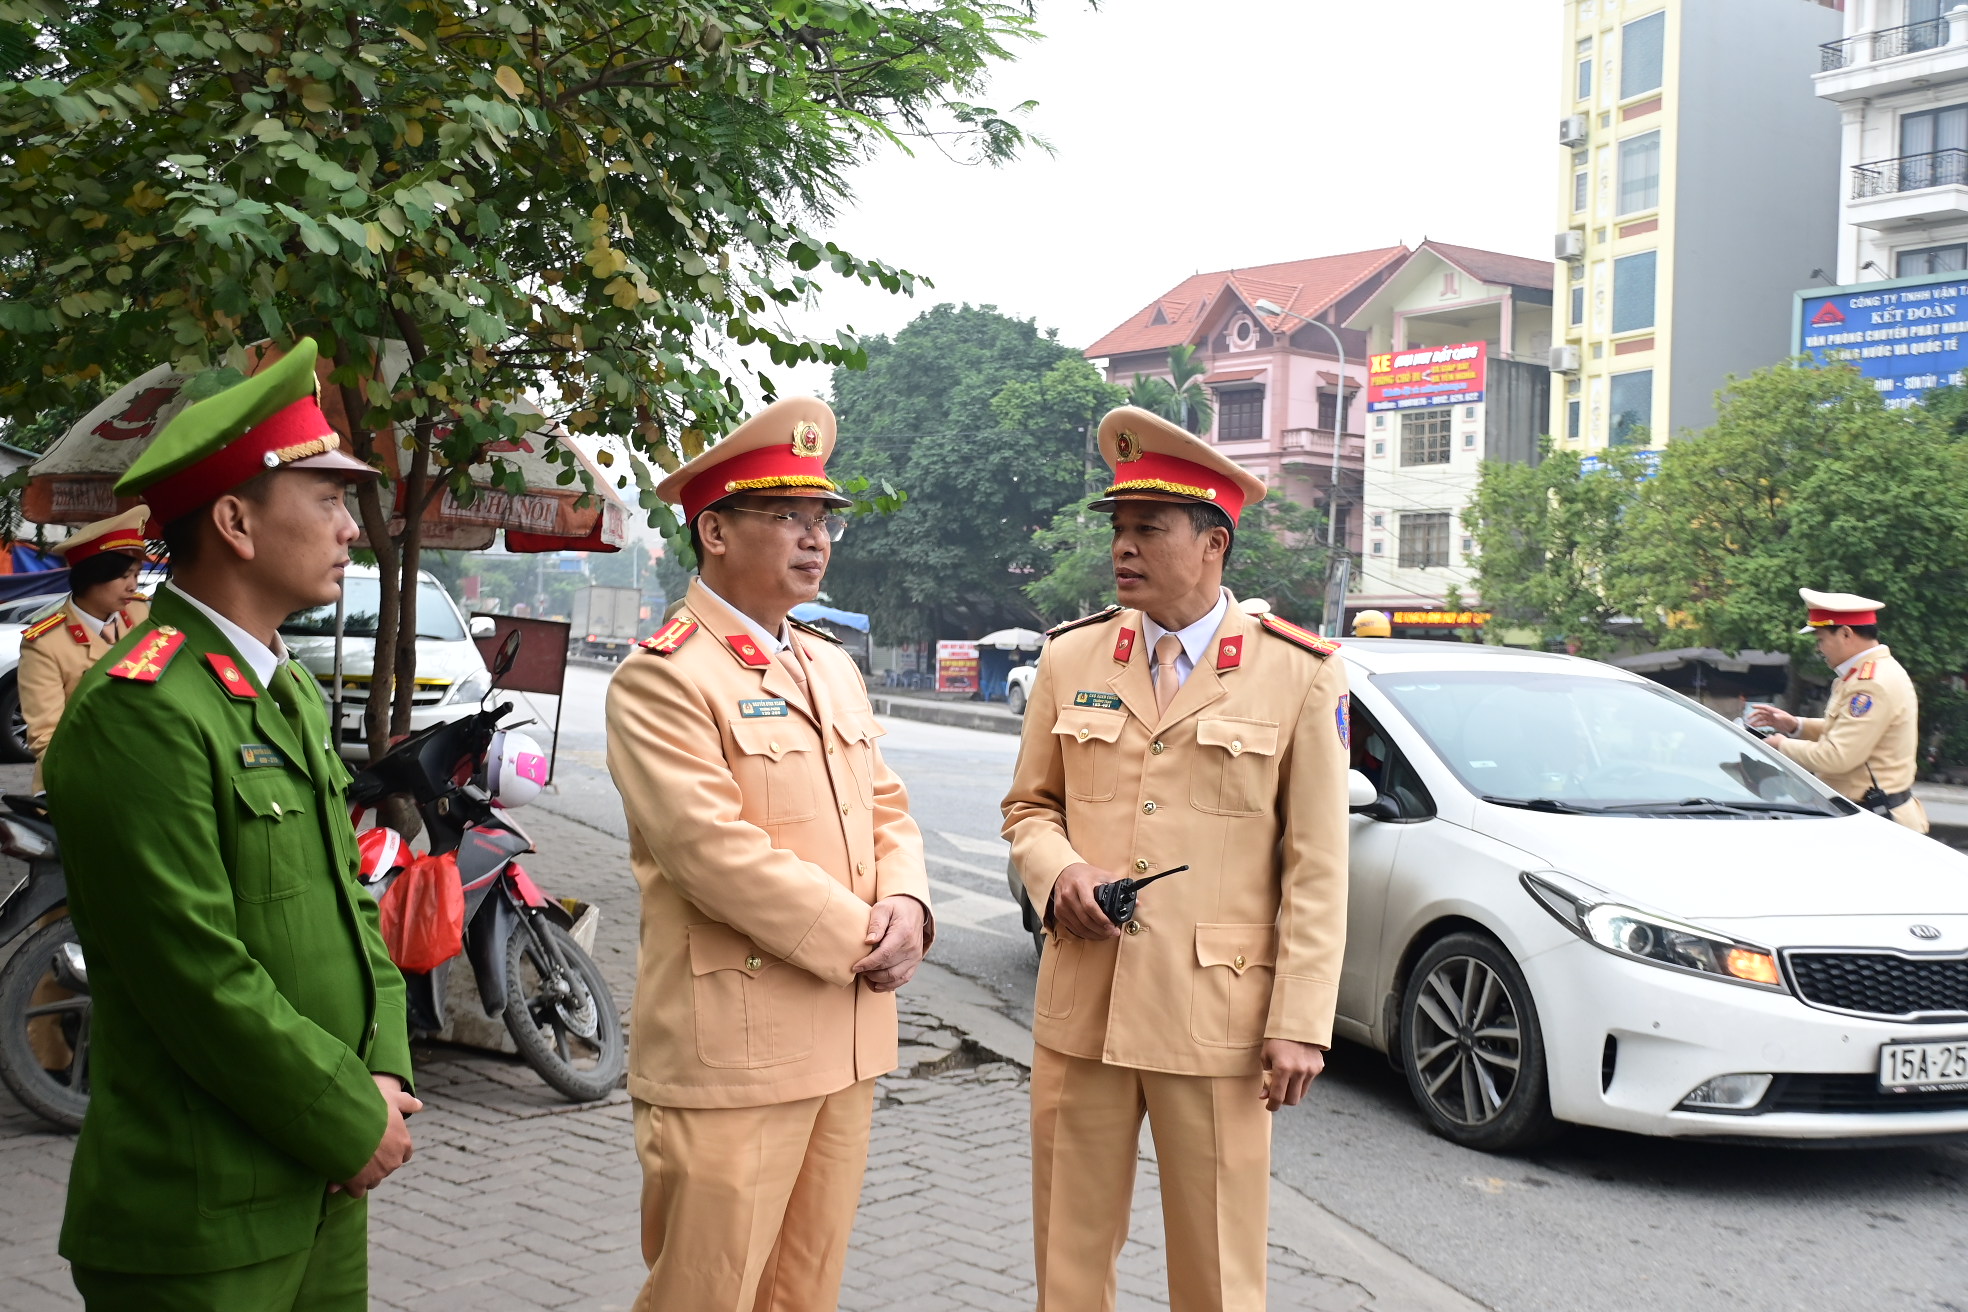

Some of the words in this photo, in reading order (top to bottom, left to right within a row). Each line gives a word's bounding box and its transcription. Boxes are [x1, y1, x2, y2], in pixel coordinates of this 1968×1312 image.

[1850, 295, 1881, 309] CÔNG
[1883, 294, 1898, 305] TY
[1901, 289, 1931, 302] TNHH
[1932, 286, 1957, 300] VẬN
[1871, 306, 1905, 324] KẾT
[1907, 302, 1956, 320] ĐOÀN
[1827, 331, 1864, 345] PHÒNG
[1865, 324, 1909, 341] CHUYỂN
[1910, 323, 1940, 337] PHÁT
[1910, 338, 1942, 355] QUỐC
[1943, 336, 1959, 351] TẾ
[1370, 354, 1392, 373] XE
[1910, 925, 1941, 939] KIA
